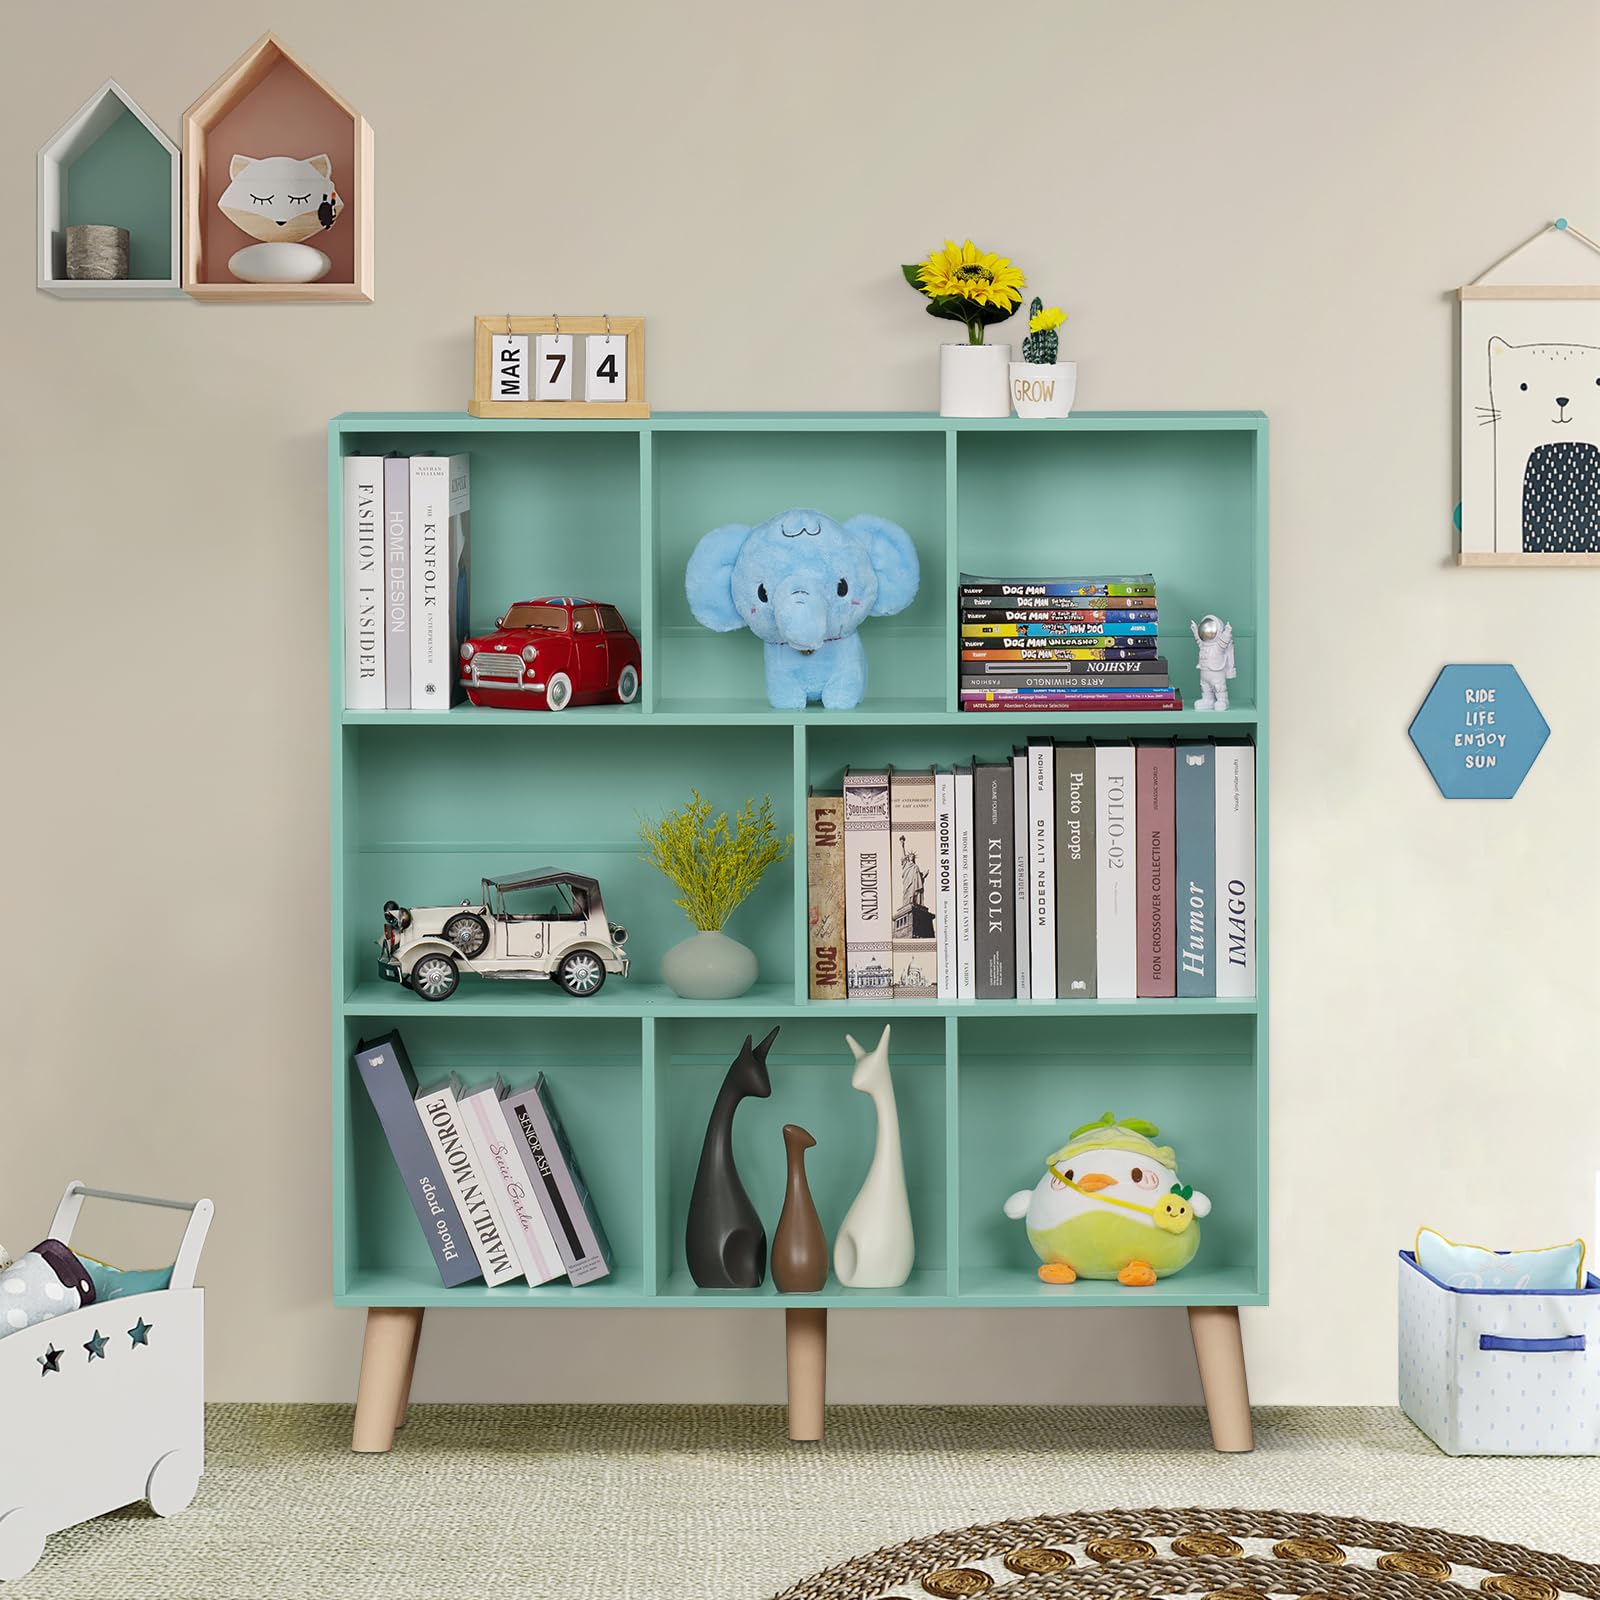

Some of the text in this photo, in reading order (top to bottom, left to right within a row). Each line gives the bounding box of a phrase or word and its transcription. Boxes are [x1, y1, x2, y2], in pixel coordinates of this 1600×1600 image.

[500, 348, 522, 395] MAR
[546, 354, 567, 384] 7
[596, 354, 619, 384] 4
[1014, 379, 1055, 403] GROW
[358, 484, 374, 573] FASHION
[389, 512, 405, 633] HOME DESION
[424, 524, 436, 608] KINFOLK
[1002, 586, 1046, 595] DOG MAN
[1006, 612, 1049, 621] DOG MAN
[1017, 598, 1033, 607] DOG
[1034, 598, 1049, 607] MAN
[1003, 638, 1025, 648] DOG
[1027, 639, 1047, 647] MAN
[1070, 624, 1104, 634] DOG MAN
[1021, 650, 1037, 659] DOG
[1038, 650, 1053, 659] MAN
[1087, 662, 1141, 672] FASHION
[1465, 689, 1496, 704] RIDE
[1466, 711, 1495, 726] LIFE
[1455, 733, 1507, 748] ENJOY
[1465, 755, 1496, 769] SUN
[1067, 772, 1084, 860] Photo props
[1107, 775, 1125, 869] FOLIO-02
[940, 814, 950, 892] WOODEN SPOON
[1037, 820, 1047, 926] MODERN LIVING
[859, 853, 879, 921] BENEDICTINS
[988, 839, 1002, 934] KINFOLK
[1152, 831, 1161, 980] FION CROSSOVER COLLECTION
[1182, 882, 1205, 977] Humor
[1228, 880, 1247, 968] IMAGO
[518, 1113, 552, 1177] SENIOR ASH
[426, 1099, 512, 1276] MARILYN MONROE
[507, 1183, 532, 1232] Garden
[419, 1177, 459, 1262] Photo props
